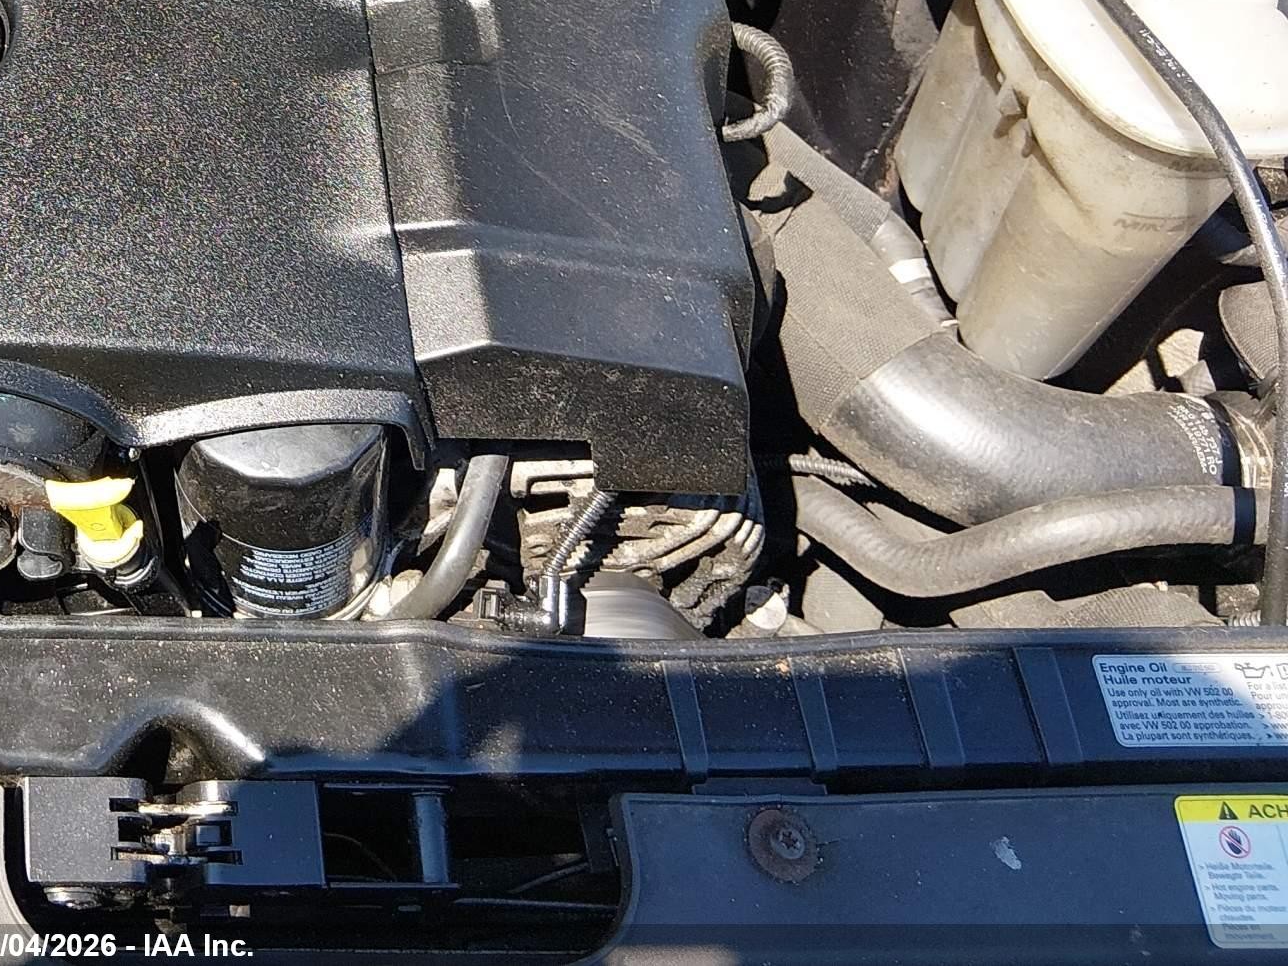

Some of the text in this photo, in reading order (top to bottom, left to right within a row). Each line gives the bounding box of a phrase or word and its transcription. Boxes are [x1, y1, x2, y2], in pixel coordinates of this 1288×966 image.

[1099, 662, 1146, 675] Engine
[1149, 662, 1168, 673] Oil
[1103, 674, 1192, 685] Huile moteur
[1107, 687, 1234, 699] Use only oil with VW 502 00
[1112, 697, 1243, 709] approval. Most are synthetic.
[1114, 710, 1150, 720] Utilisez
[1208, 710, 1225, 719] des
[1120, 720, 1253, 731] avec VW 502 00 approbation.
[1121, 731, 1134, 741] La
[1135, 731, 1170, 743] plupart
[1171, 732, 1193, 741] sont
